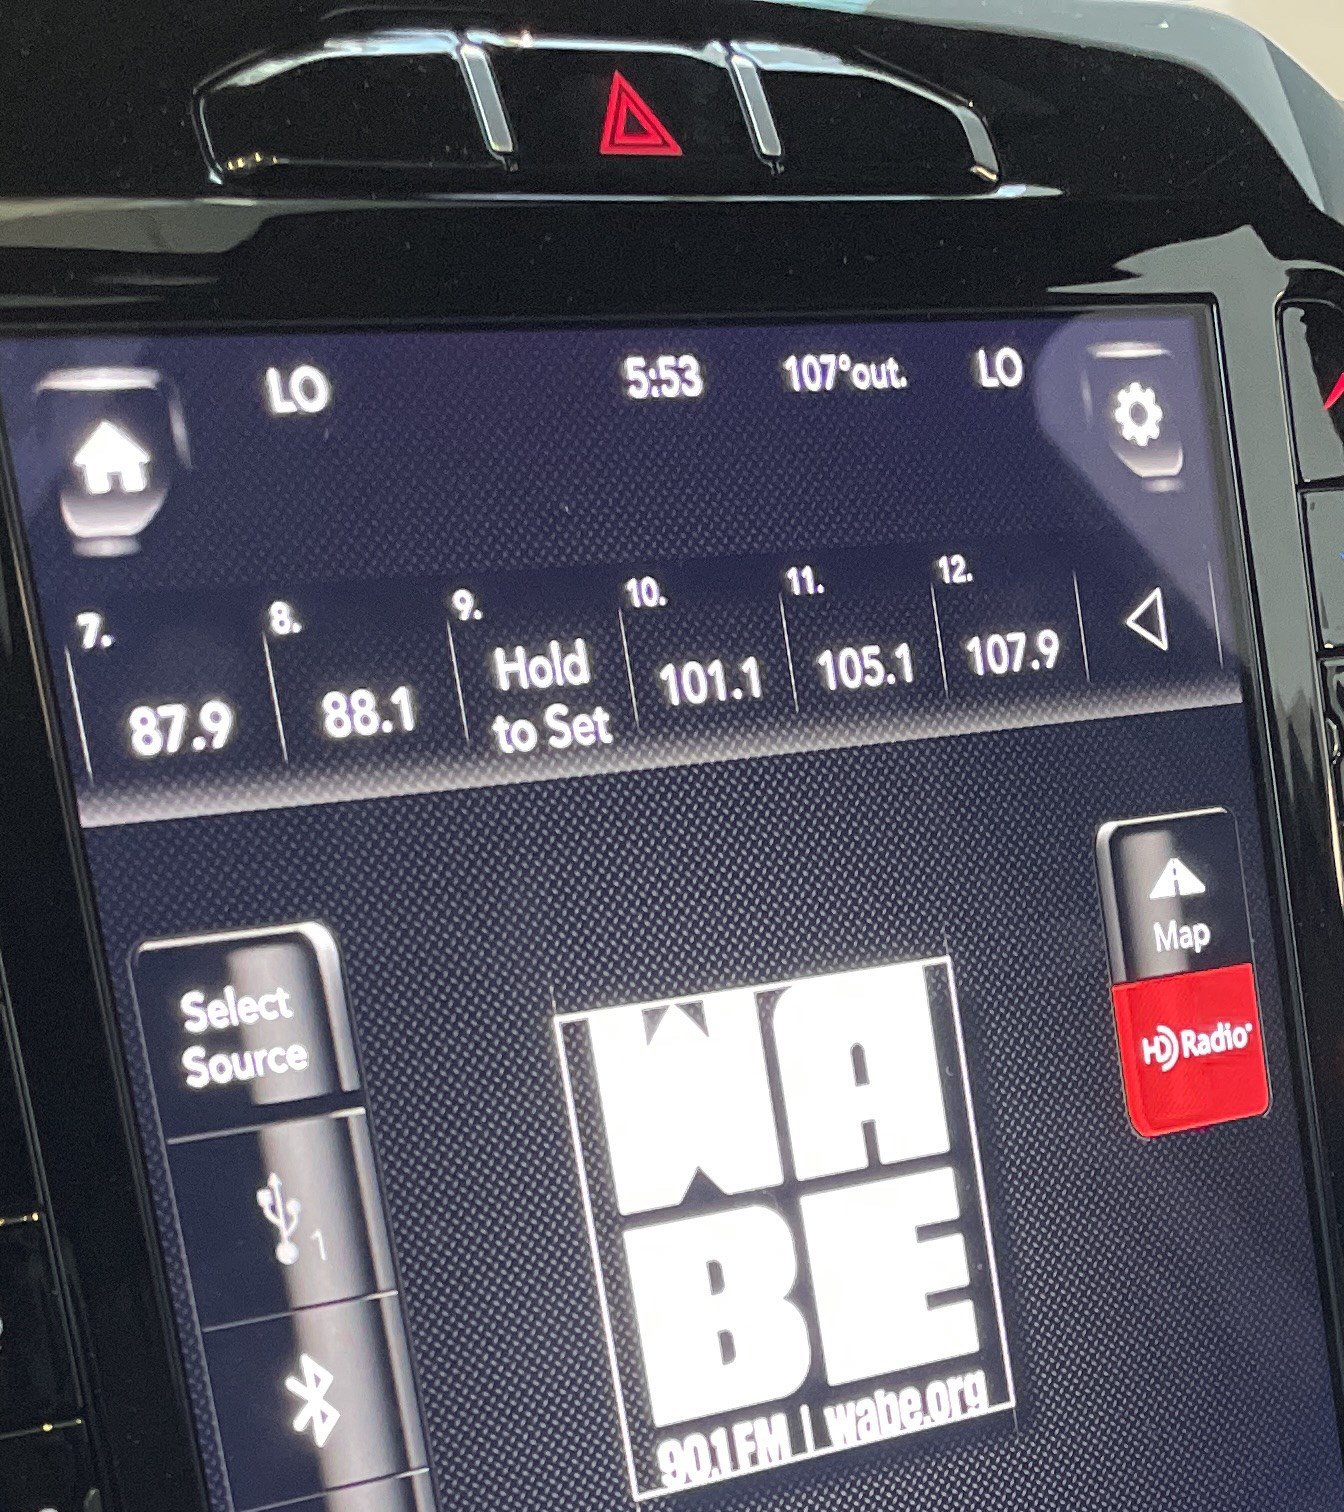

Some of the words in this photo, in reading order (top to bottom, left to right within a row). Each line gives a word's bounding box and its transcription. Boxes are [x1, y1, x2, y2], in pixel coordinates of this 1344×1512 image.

[265, 364, 331, 416] LO
[622, 354, 705, 400] 5:53
[976, 347, 1024, 389] LO
[626, 577, 668, 609] 10.
[787, 566, 825, 597] 11.
[938, 555, 974, 586] 12.
[270, 602, 302, 636] 8.
[452, 590, 483, 622] 9.
[78, 614, 114, 649] 7.
[967, 630, 1059, 678] 107.9
[495, 639, 590, 691] Hold
[660, 656, 761, 706] 101.1
[818, 642, 914, 693] 105.1
[129, 700, 234, 759] 87.9
[322, 686, 417, 739] 88.1
[493, 714, 536, 754] to
[545, 703, 612, 749] Set
[1153, 919, 1211, 953] Map
[180, 985, 294, 1034] Select
[181, 1043, 308, 1088] Source
[311, 1230, 327, 1260] 1
[823, 1370, 989, 1446] wabe.org
